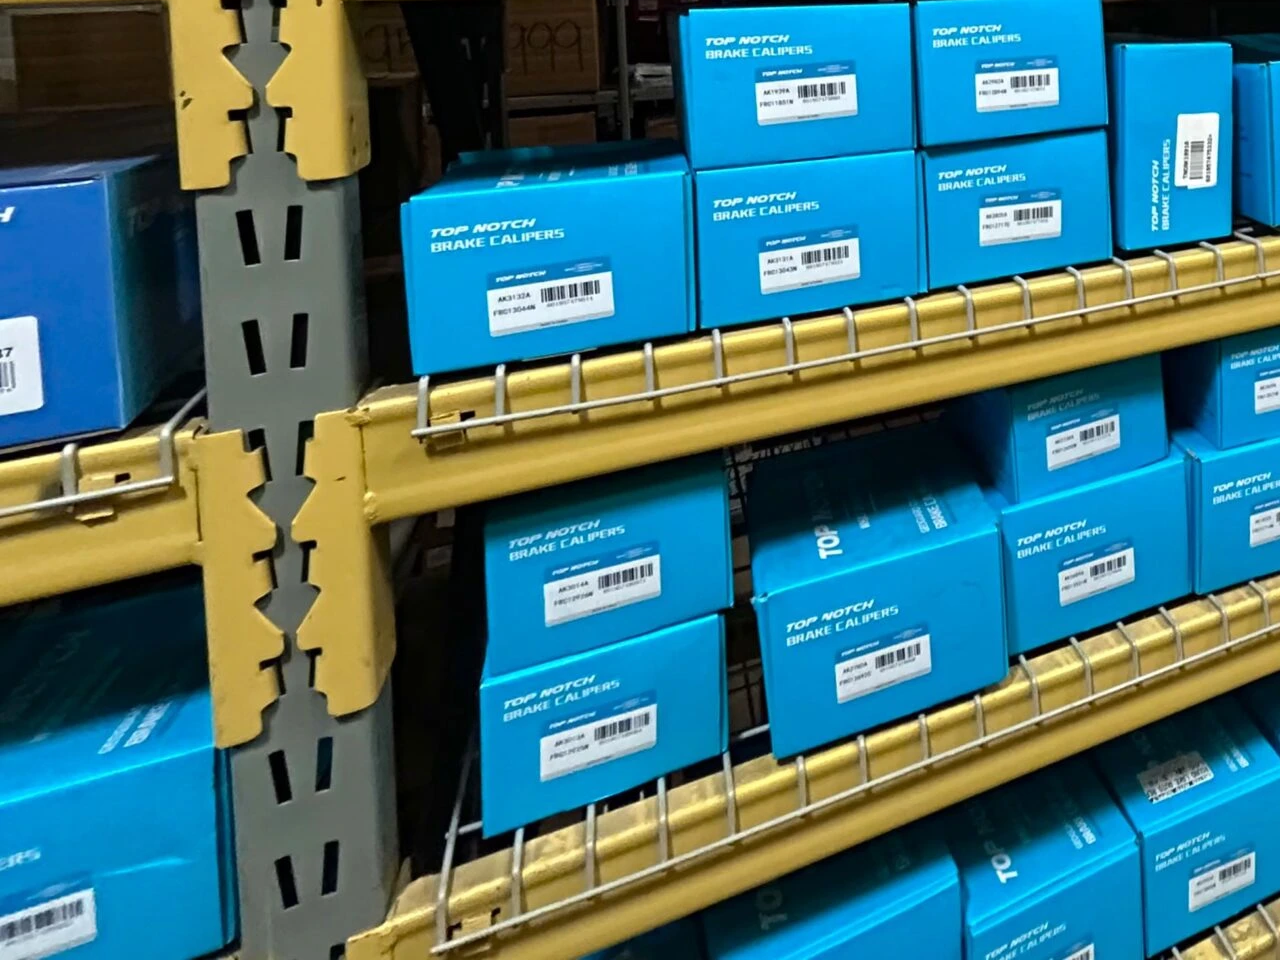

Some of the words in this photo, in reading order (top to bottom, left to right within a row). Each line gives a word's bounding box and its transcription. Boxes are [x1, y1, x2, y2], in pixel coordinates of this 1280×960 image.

[933, 27, 957, 36] TOP
[960, 24, 1001, 34] NOTCH
[706, 37, 736, 46] TOP
[739, 35, 789, 44] NOTCH
[933, 38, 968, 48] BRAKE
[972, 34, 1021, 44] CALIPERS
[706, 49, 748, 59] BRAKE
[752, 46, 812, 56] CALIPERS
[939, 170, 963, 180] TOP
[966, 165, 1006, 176] NOTCH
[1162, 139, 1171, 192] CALIPERS
[938, 180, 973, 191] BRAKE
[976, 174, 1026, 186] CALIPERS
[1151, 159, 1160, 204] NOTCH
[714, 198, 743, 208] TOP
[746, 192, 796, 204] NOTCH
[714, 208, 755, 221] BRAKE
[760, 202, 819, 215] CALIPERS
[1161, 194, 1170, 231] BRAKE
[431, 226, 468, 238] TOP
[473, 219, 536, 233] NOTCH
[431, 238, 484, 252] BRAKE
[490, 229, 564, 246] CALIPERS
[781, 236, 806, 244] NOTCH
[496, 275, 514, 283] TOP
[515, 270, 547, 279] NOTCH
[1214, 482, 1234, 493] TOP
[1236, 472, 1271, 487] NOTCH
[1213, 491, 1242, 504] BRAKE
[510, 534, 542, 548] TOP
[546, 520, 600, 540] NOTCH
[1017, 542, 1051, 558] BRAKE
[1056, 526, 1106, 546] CALIPERS
[1018, 533, 1042, 546] TOP
[1045, 520, 1086, 538] NOTCH
[510, 542, 556, 560] BRAKE
[560, 526, 625, 548] CALIPERS
[552, 568, 569, 576] TOP
[570, 560, 599, 570] NOTCH
[787, 616, 818, 632] TOP
[822, 600, 874, 620] NOTCH
[786, 626, 830, 646] BRAKE
[836, 606, 898, 631] CALIPERS
[504, 693, 536, 709] TOP
[540, 675, 595, 698] NOTCH
[504, 701, 548, 721] BRAKE
[555, 680, 620, 706] CALIPERS
[549, 720, 567, 729] TOP
[567, 711, 597, 724] NOTCH
